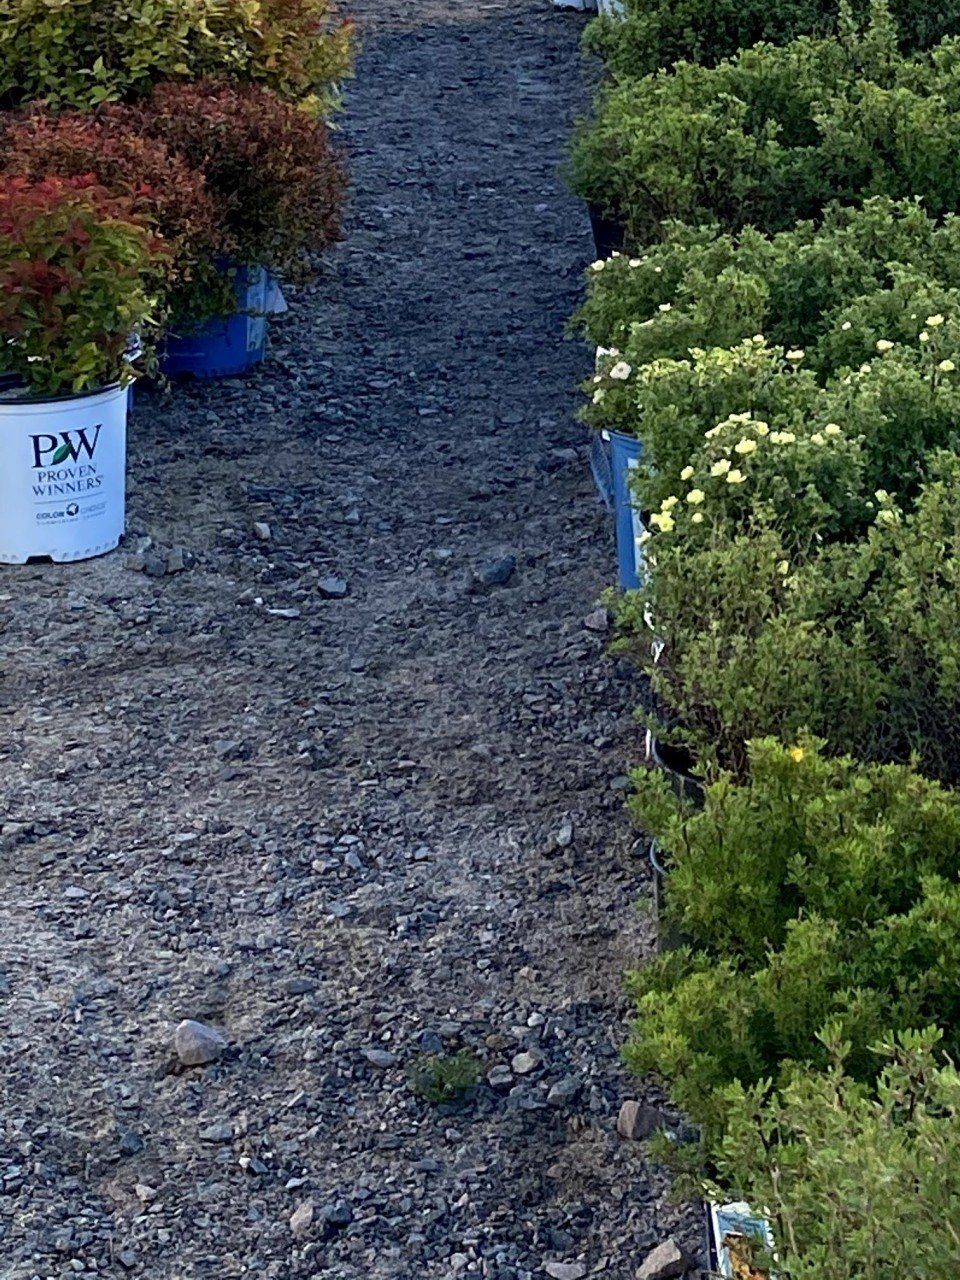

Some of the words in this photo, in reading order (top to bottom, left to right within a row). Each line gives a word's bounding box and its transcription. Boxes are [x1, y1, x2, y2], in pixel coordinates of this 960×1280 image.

[28, 424, 103, 469] PW
[37, 464, 97, 483] PROVEN
[32, 476, 103, 496] WINNERS
